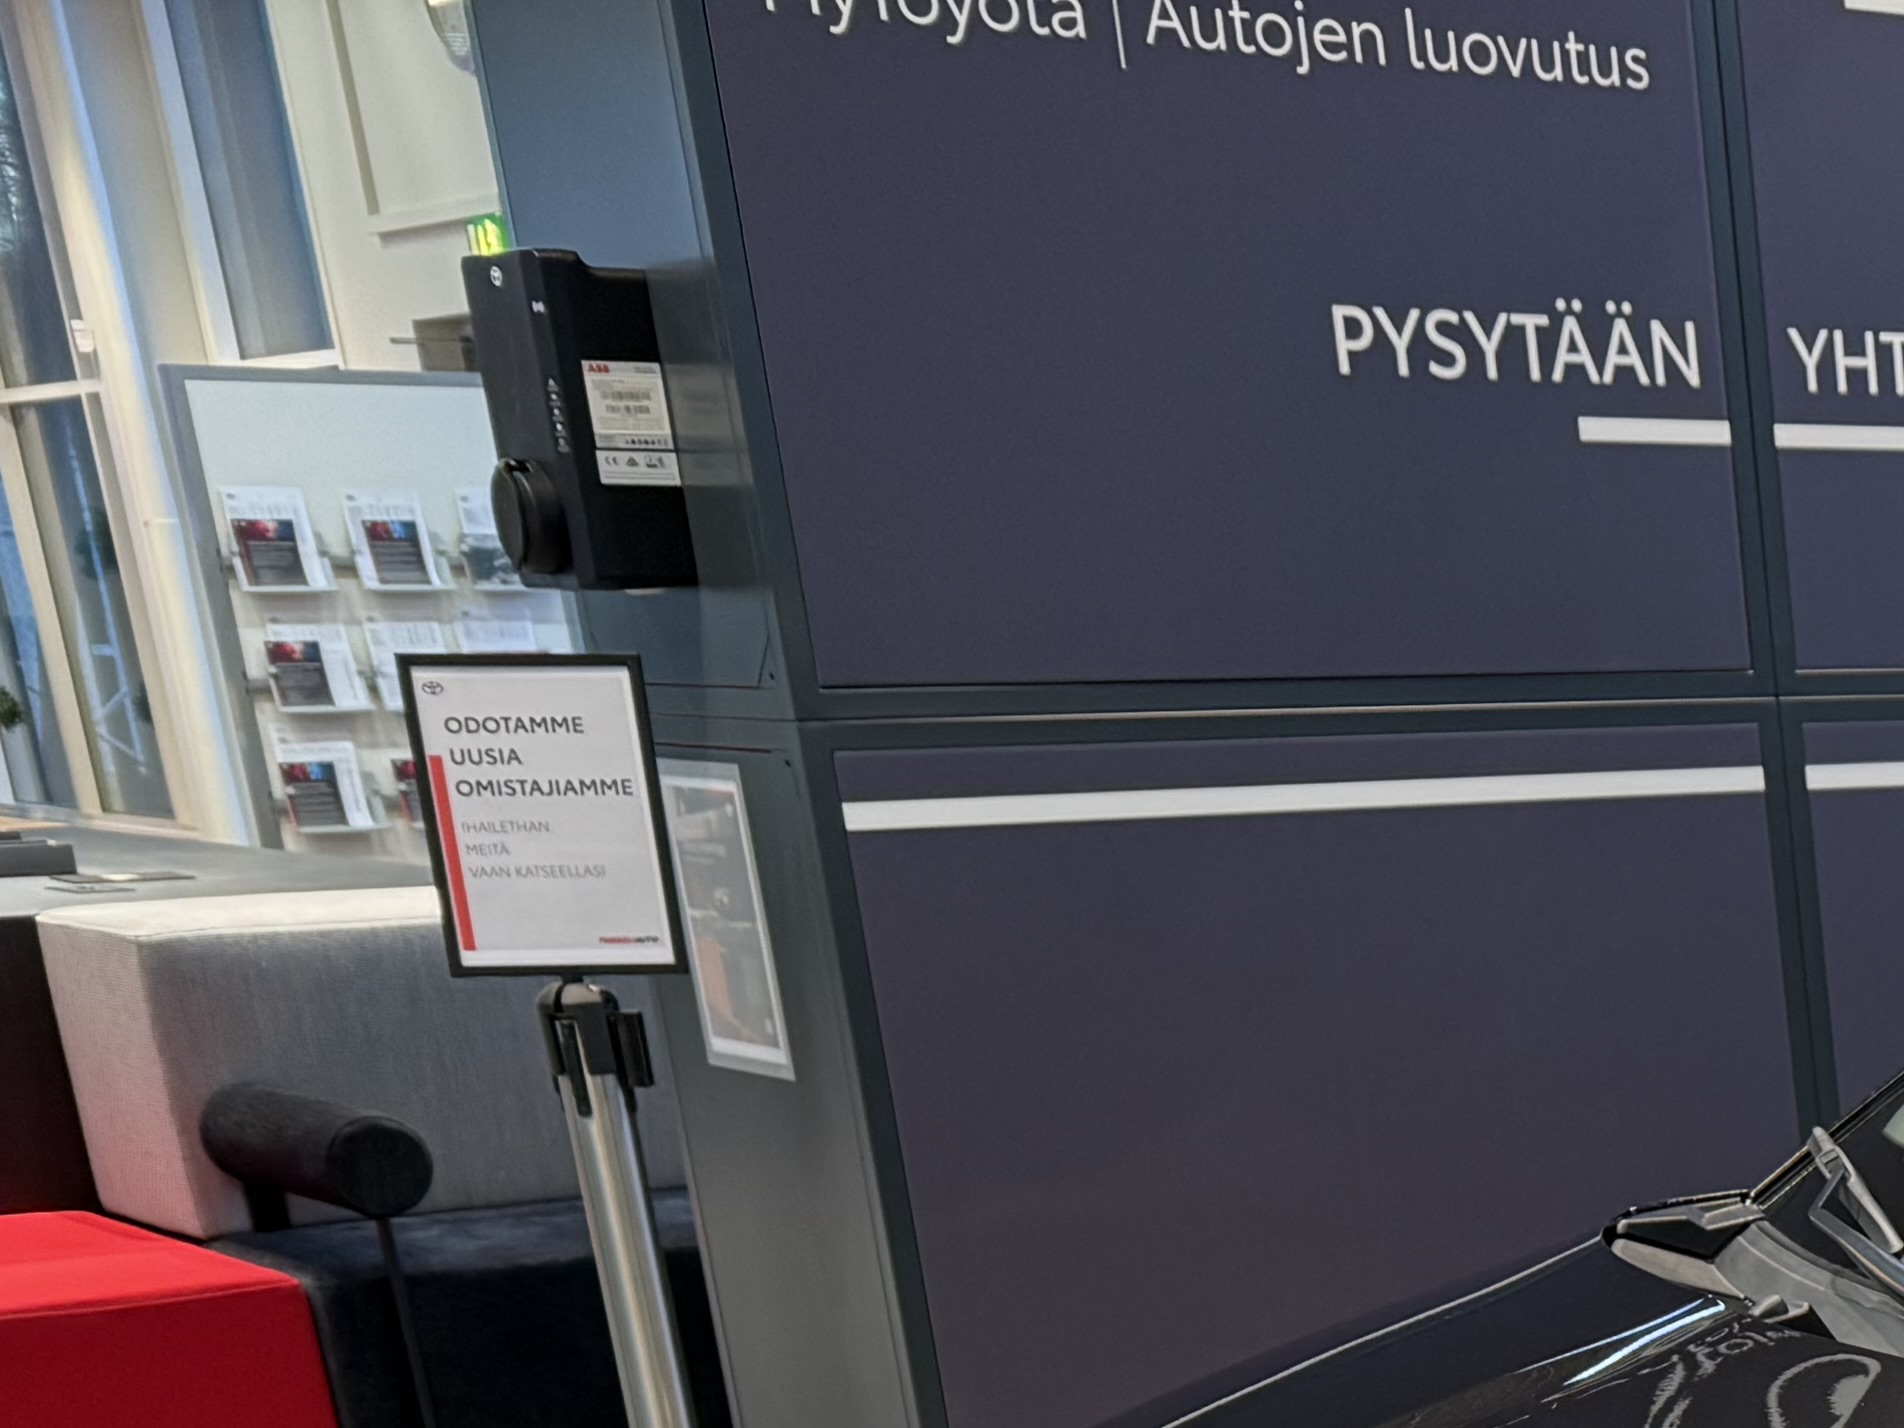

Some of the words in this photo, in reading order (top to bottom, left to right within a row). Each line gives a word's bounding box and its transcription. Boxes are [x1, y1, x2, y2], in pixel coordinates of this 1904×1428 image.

[1146, 0, 1387, 74] Autojen
[1404, 7, 1651, 90] luovutus
[1331, 297, 1701, 389] PYSYTÄÄN
[444, 716, 585, 735] ODOTAMME
[449, 747, 524, 766] UUSIA
[455, 778, 634, 798] OMISTAJIAMME
[465, 841, 511, 856] MEITÄ
[469, 865, 511, 879] VAAN
